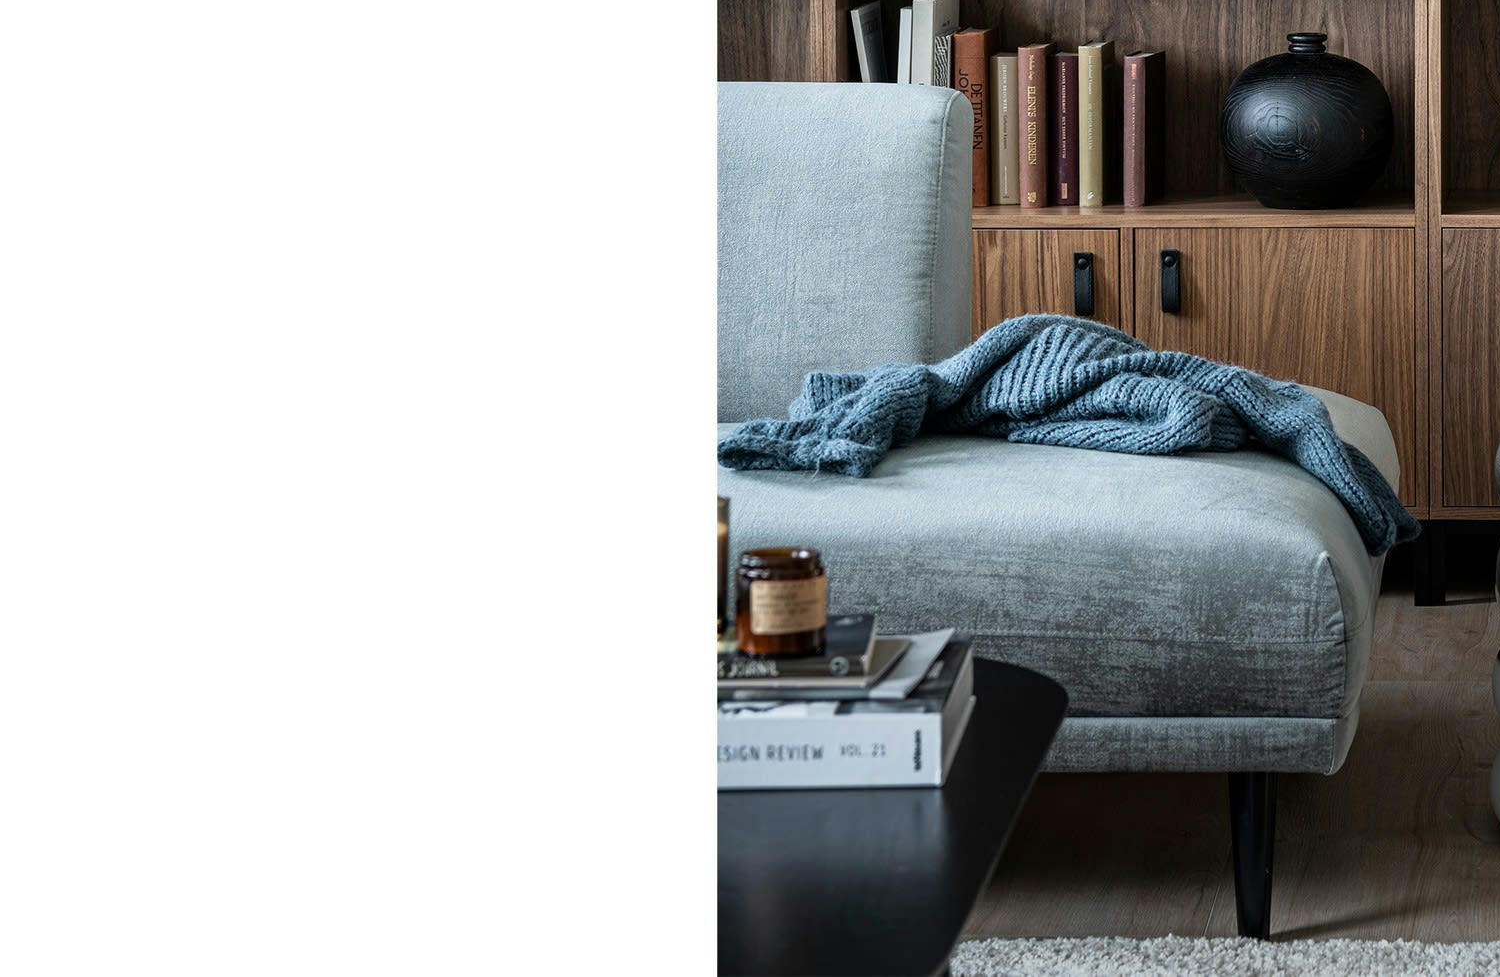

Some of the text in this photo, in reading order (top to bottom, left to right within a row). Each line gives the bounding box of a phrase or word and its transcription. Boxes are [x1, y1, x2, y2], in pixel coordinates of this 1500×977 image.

[970, 83, 983, 98] DE
[1027, 86, 1037, 117] ELENI'S
[1027, 122, 1037, 165] KINDEREN
[766, 744, 824, 761] REVIEW
